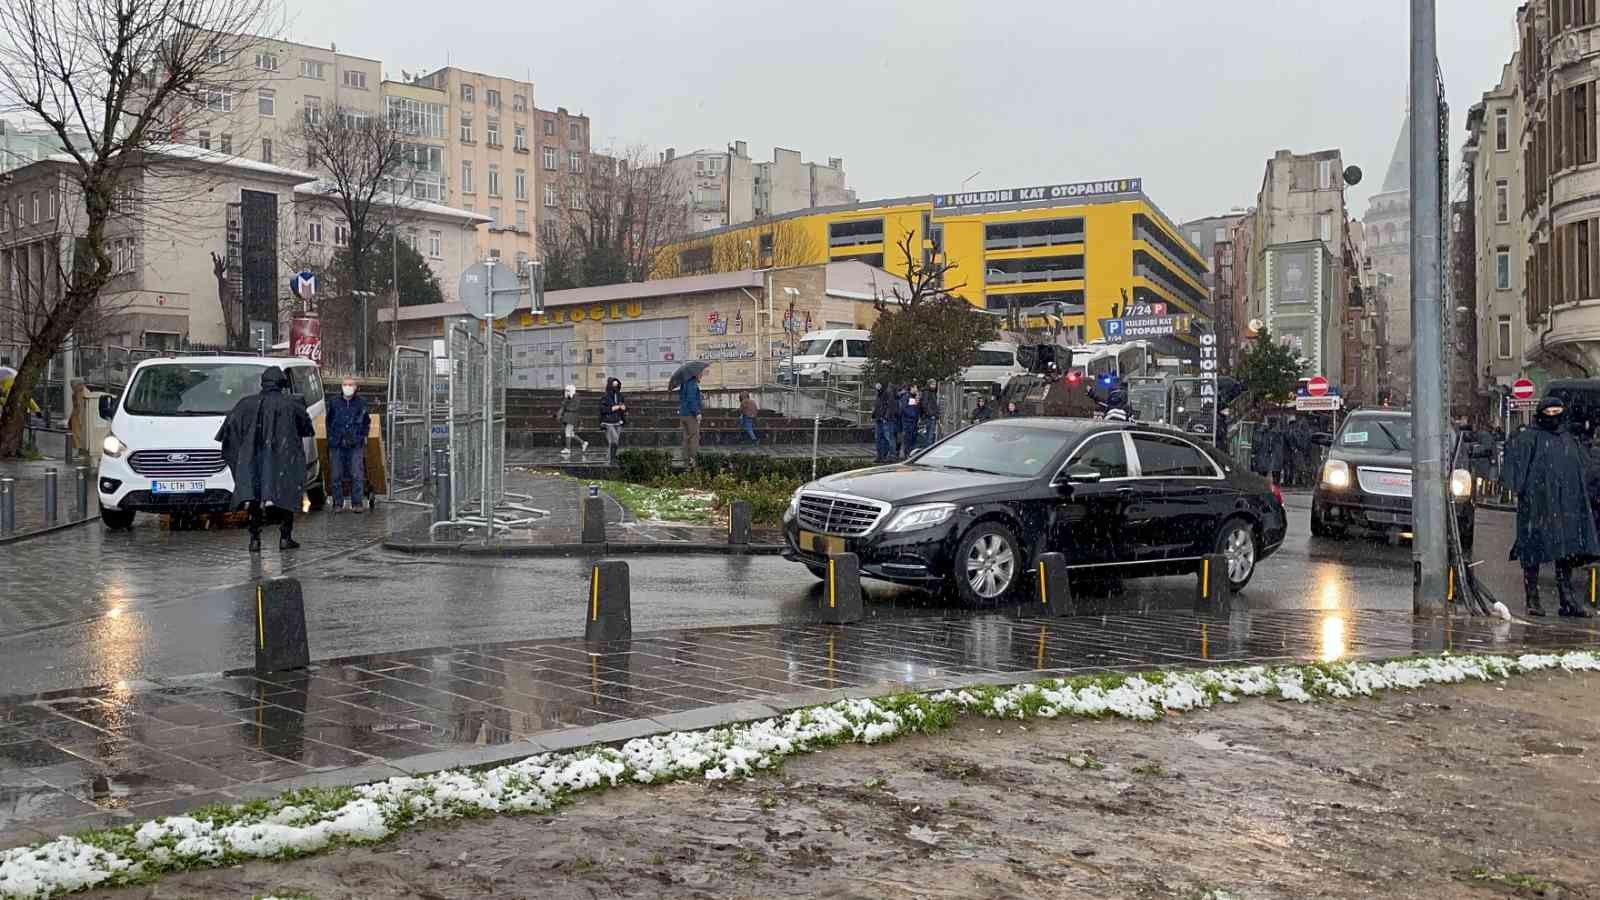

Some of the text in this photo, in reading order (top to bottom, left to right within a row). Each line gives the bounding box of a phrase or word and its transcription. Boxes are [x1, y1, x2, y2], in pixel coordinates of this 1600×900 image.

[955, 188, 1013, 206] KULEDİBİ
[1019, 187, 1046, 201] KAT
[1050, 180, 1120, 198] OTOPARKI
[1125, 304, 1152, 316] 7/24
